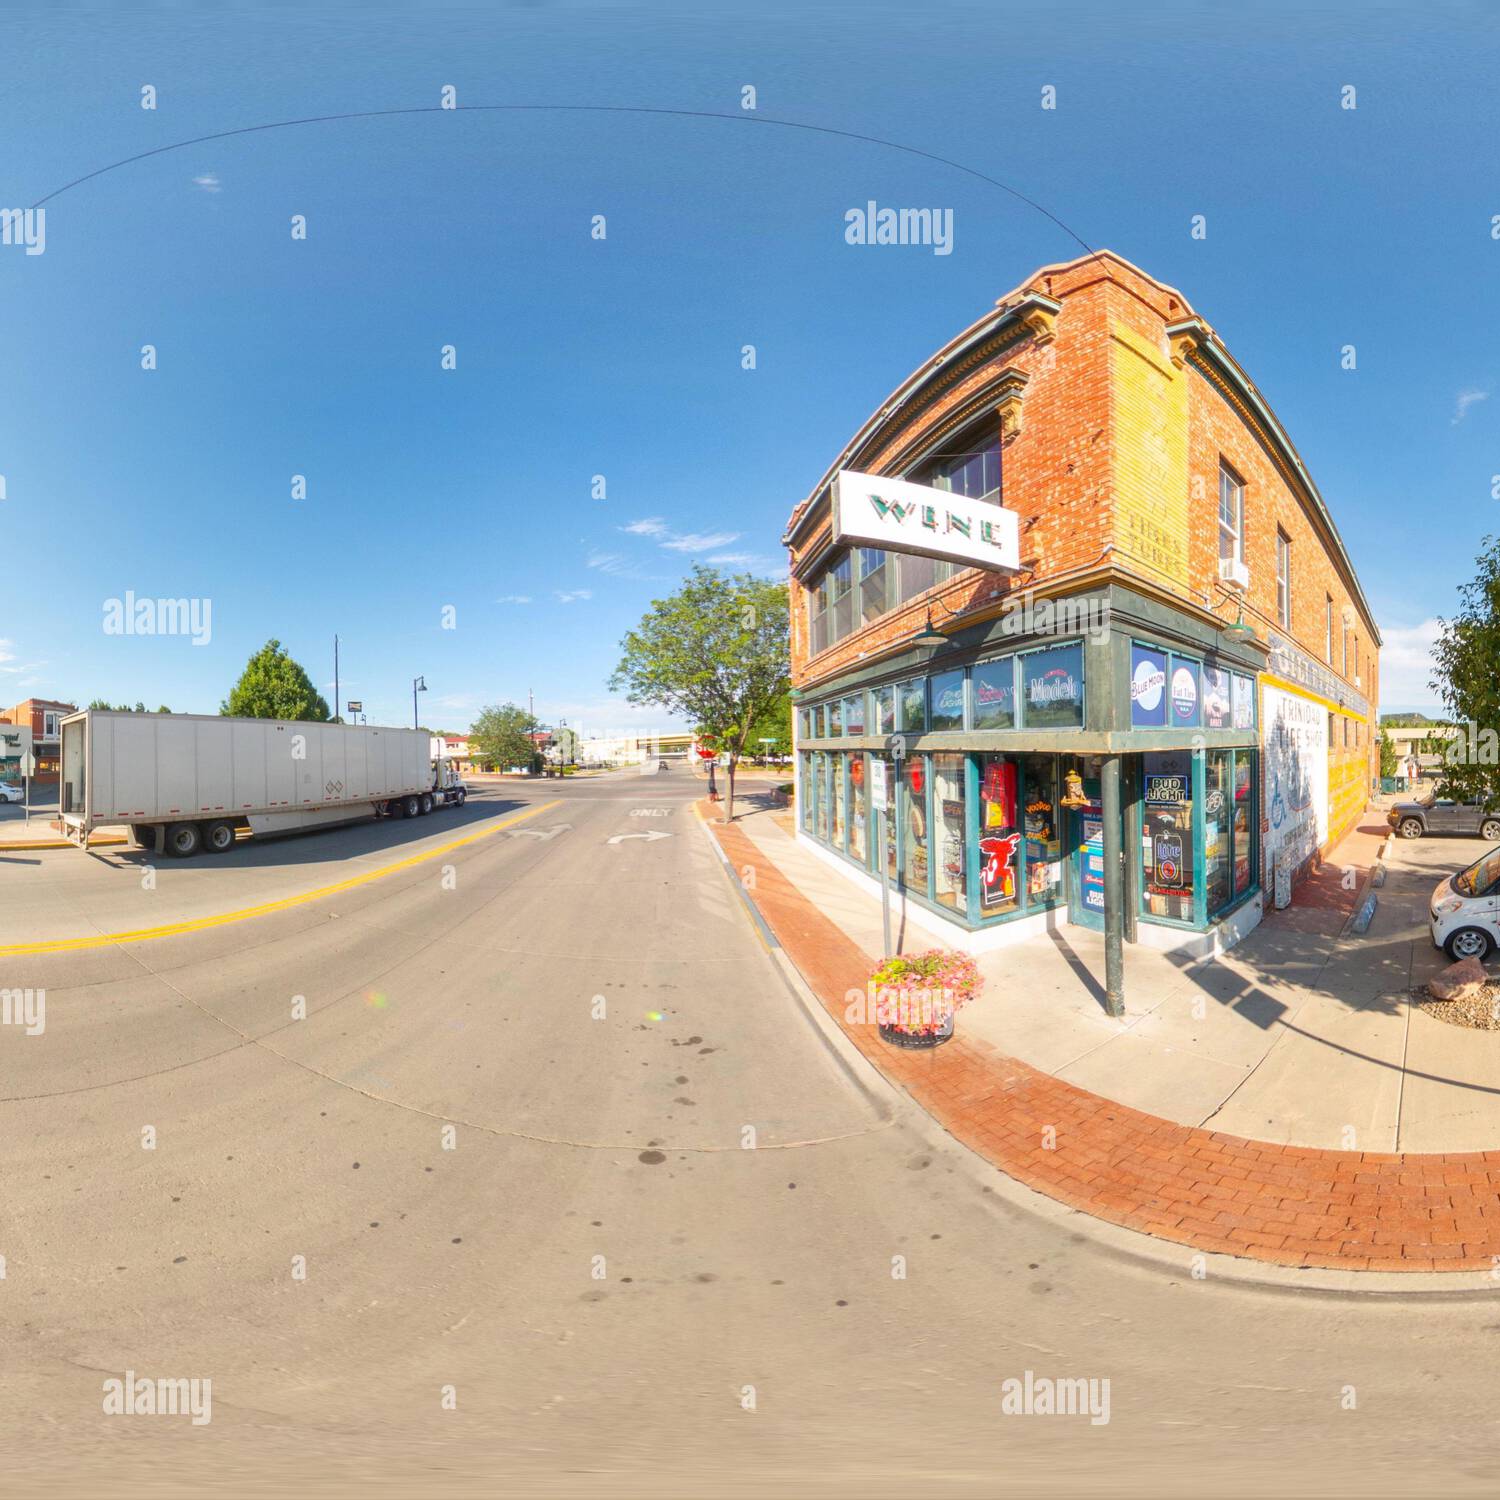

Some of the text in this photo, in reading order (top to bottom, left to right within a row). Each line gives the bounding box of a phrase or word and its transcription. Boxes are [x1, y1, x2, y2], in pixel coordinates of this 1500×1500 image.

[867, 494, 1003, 549] WINE
[1149, 673, 1164, 689] MOON
[1152, 778, 1181, 789] BUD
[1147, 788, 1185, 801] LIGHT
[629, 808, 671, 817] ONLY
